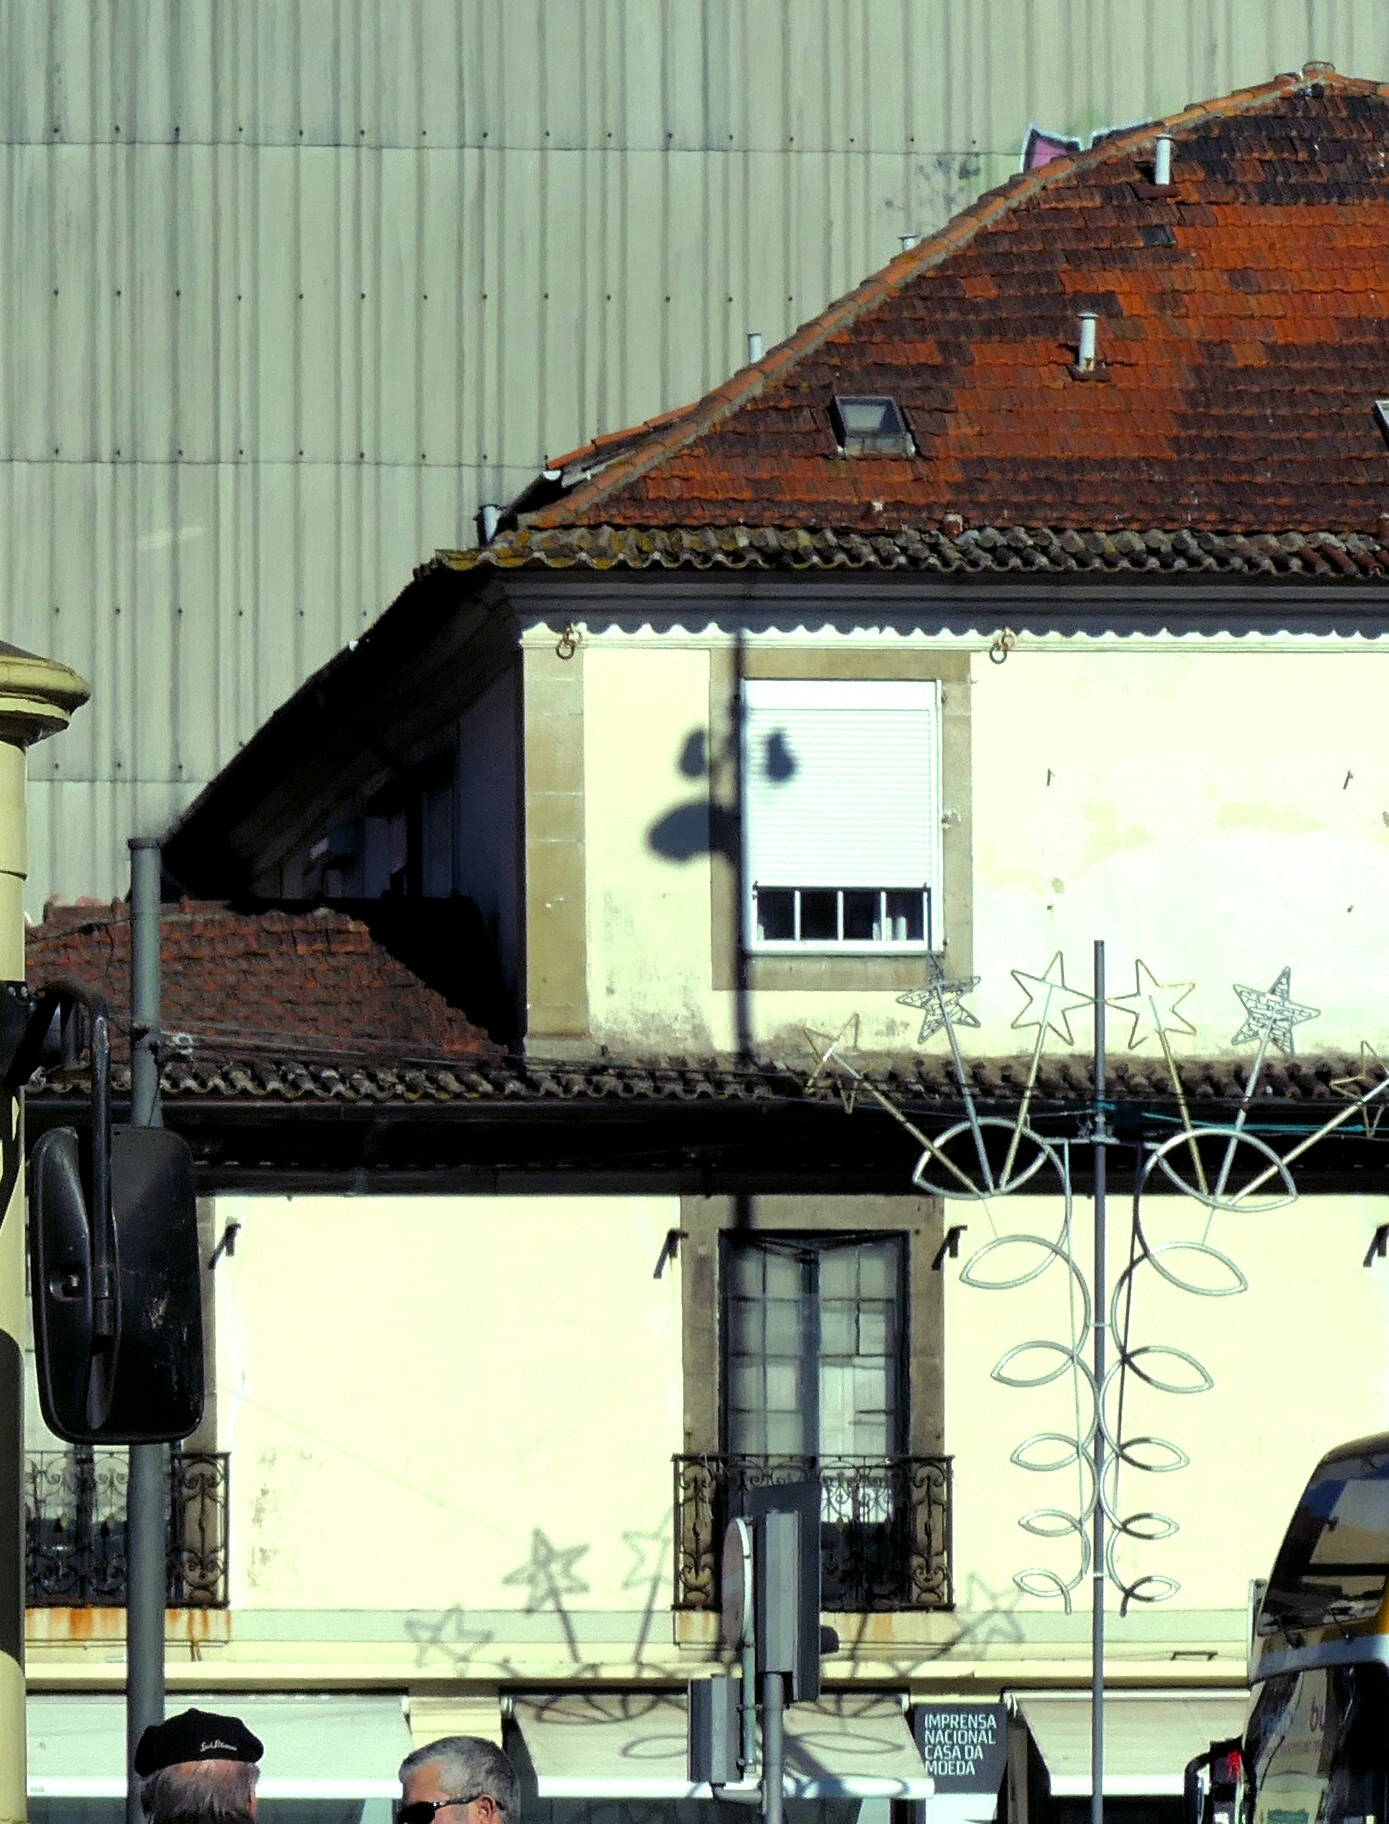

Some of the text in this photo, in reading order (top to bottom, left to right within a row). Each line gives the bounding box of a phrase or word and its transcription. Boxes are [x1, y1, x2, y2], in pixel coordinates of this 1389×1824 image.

[924, 1713, 997, 1729] IMPRENSA
[924, 1729, 997, 1744] NACIONAL
[924, 1745, 984, 1760] CASA DA
[925, 1760, 976, 1775] MOEDA
